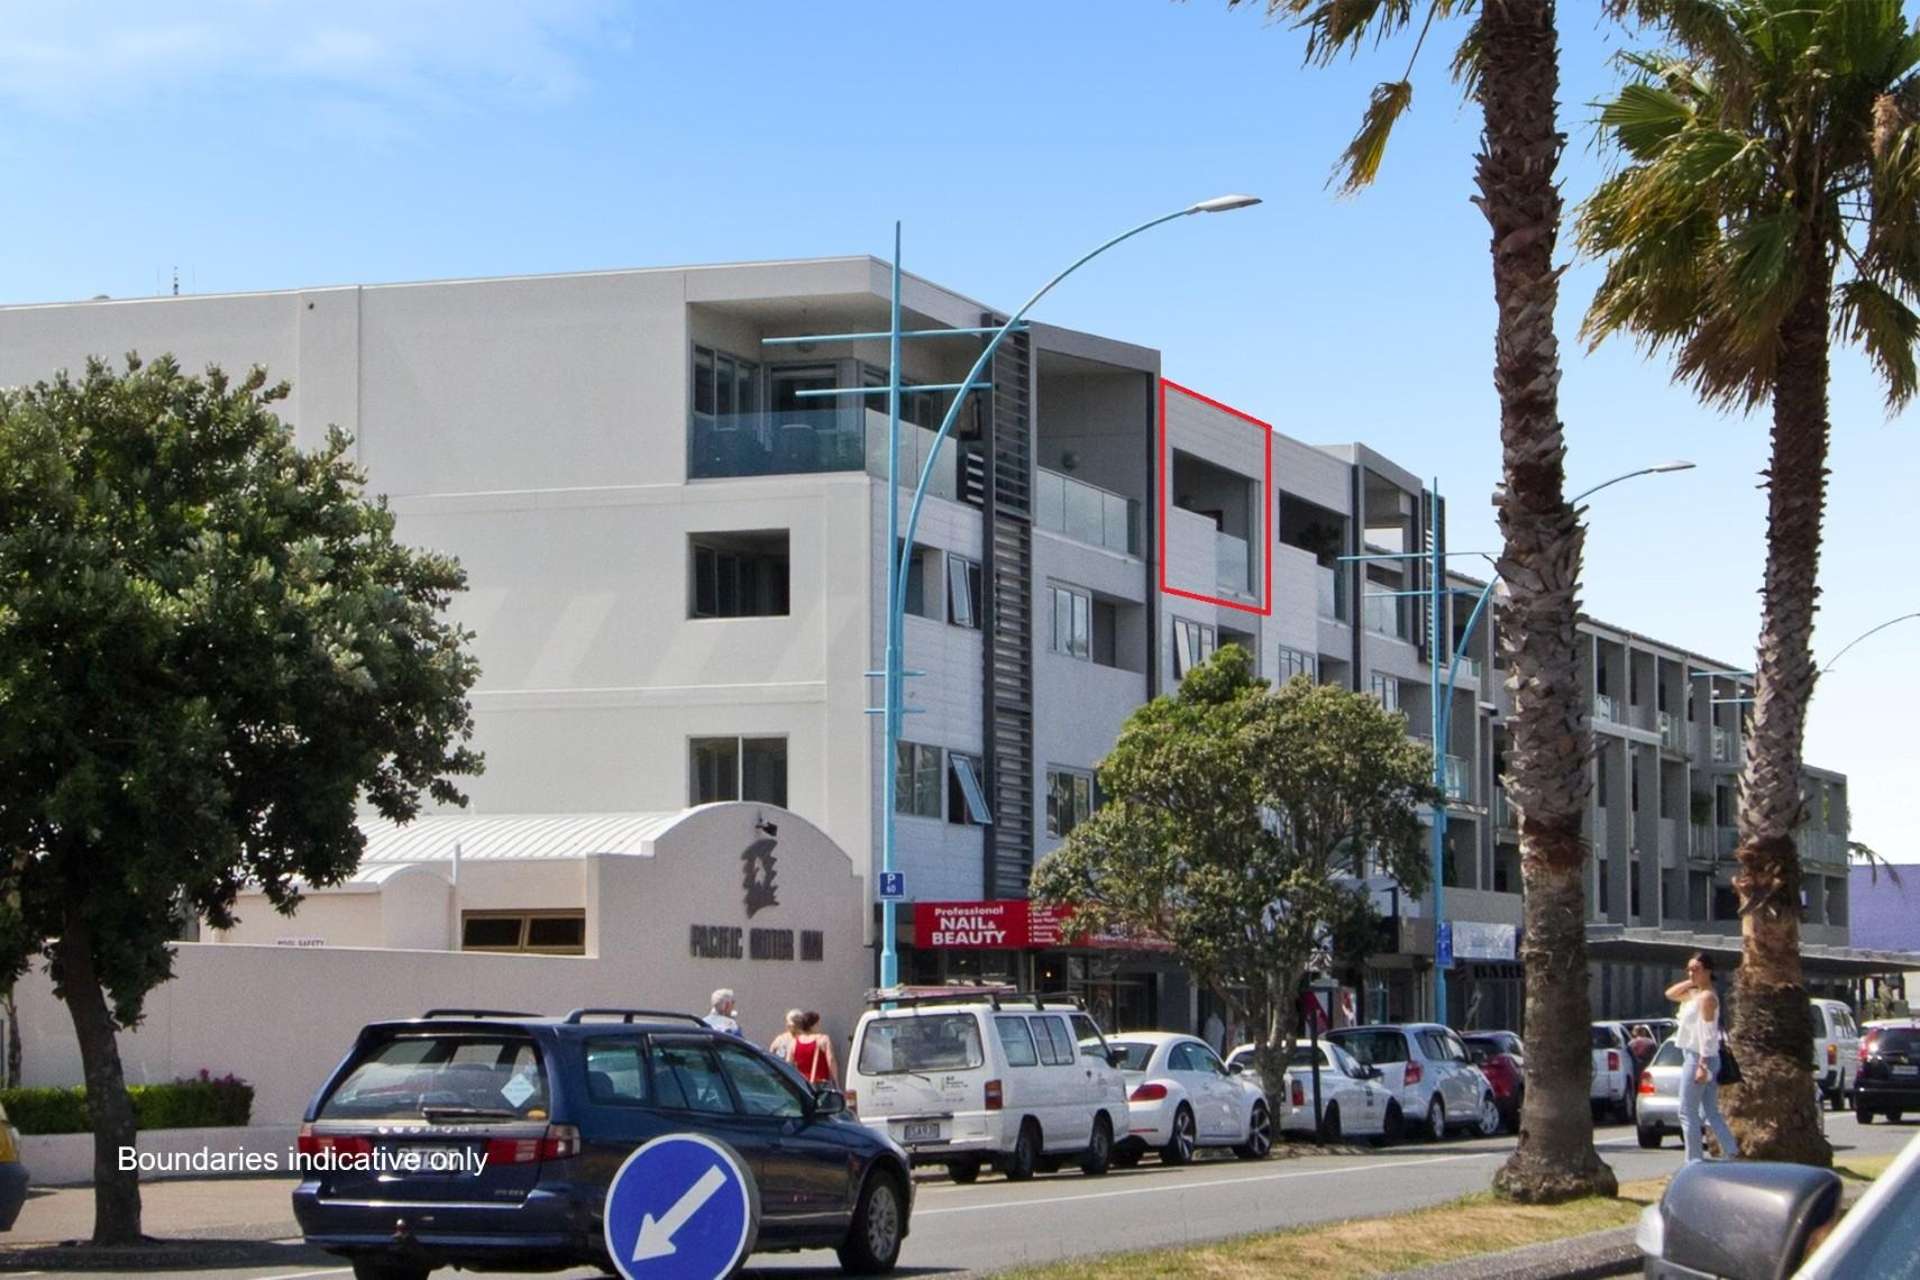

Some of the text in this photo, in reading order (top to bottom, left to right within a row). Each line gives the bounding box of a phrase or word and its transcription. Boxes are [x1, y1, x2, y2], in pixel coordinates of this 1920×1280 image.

[887, 873, 896, 885] P
[934, 905, 1004, 917] Professional
[690, 924, 743, 959] PACIFIC
[931, 930, 1007, 945] BEAUTY
